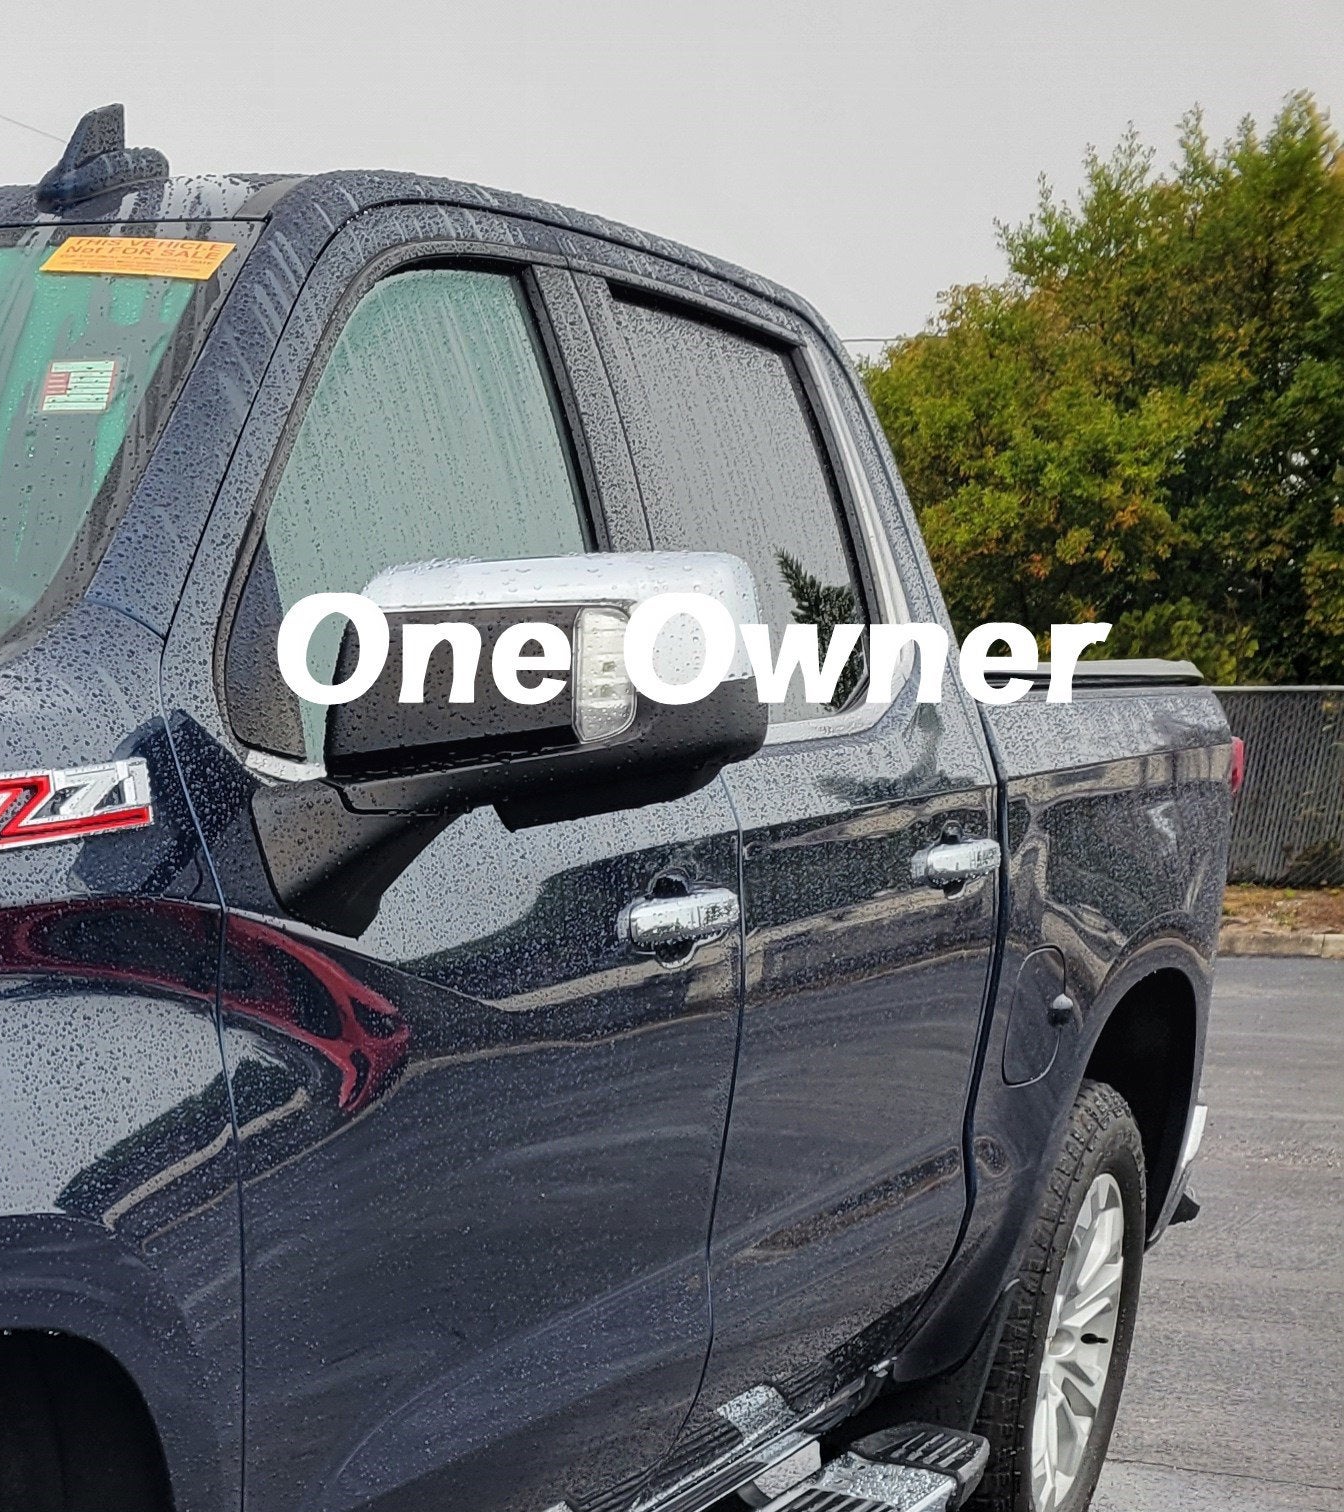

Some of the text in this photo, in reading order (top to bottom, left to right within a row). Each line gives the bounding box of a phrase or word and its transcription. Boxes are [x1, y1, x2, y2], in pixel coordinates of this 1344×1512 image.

[76, 238, 222, 251] THIS VEHICLE
[65, 246, 104, 254] Not
[109, 246, 154, 256] FOR
[160, 249, 219, 260] SALE
